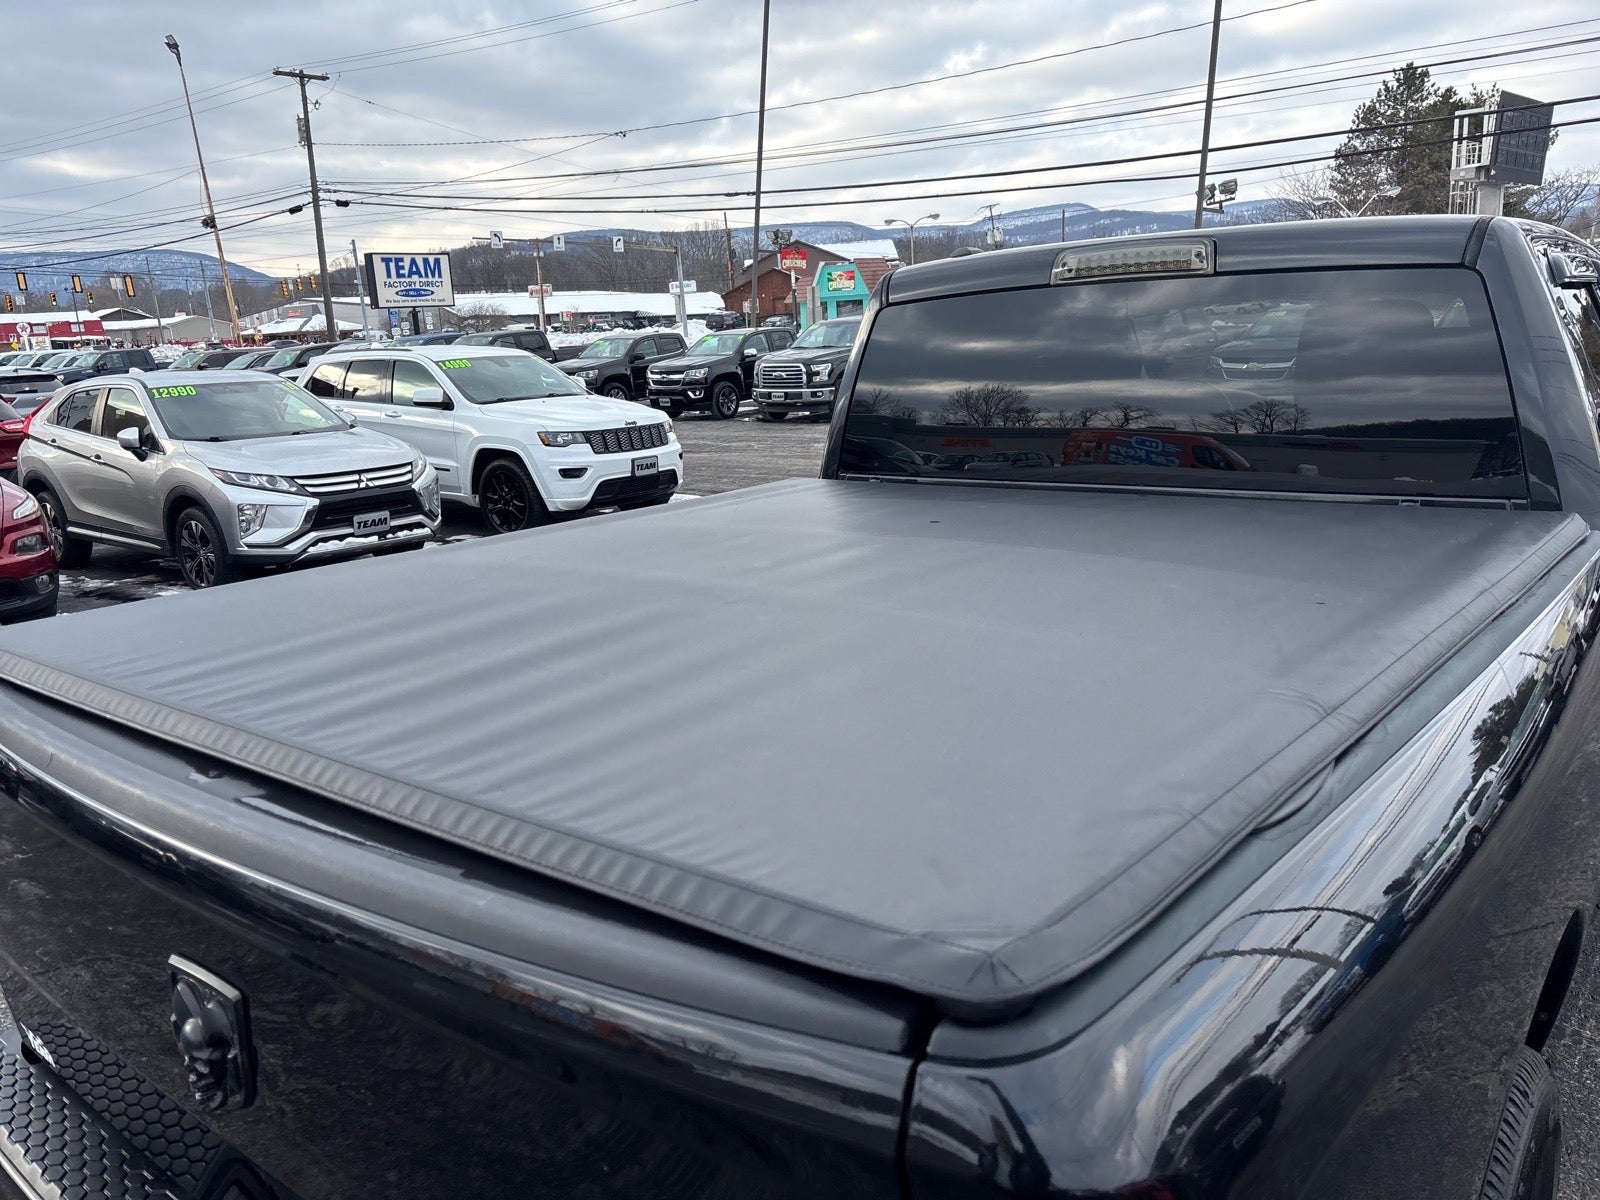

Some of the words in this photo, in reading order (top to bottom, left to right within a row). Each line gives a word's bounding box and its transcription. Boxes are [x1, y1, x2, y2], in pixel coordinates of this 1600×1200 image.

[381, 257, 443, 278] TEAM
[438, 359, 472, 370] 14990
[151, 385, 197, 399] 12990
[636, 462, 656, 471] TEAM
[356, 517, 388, 529] TEAM
